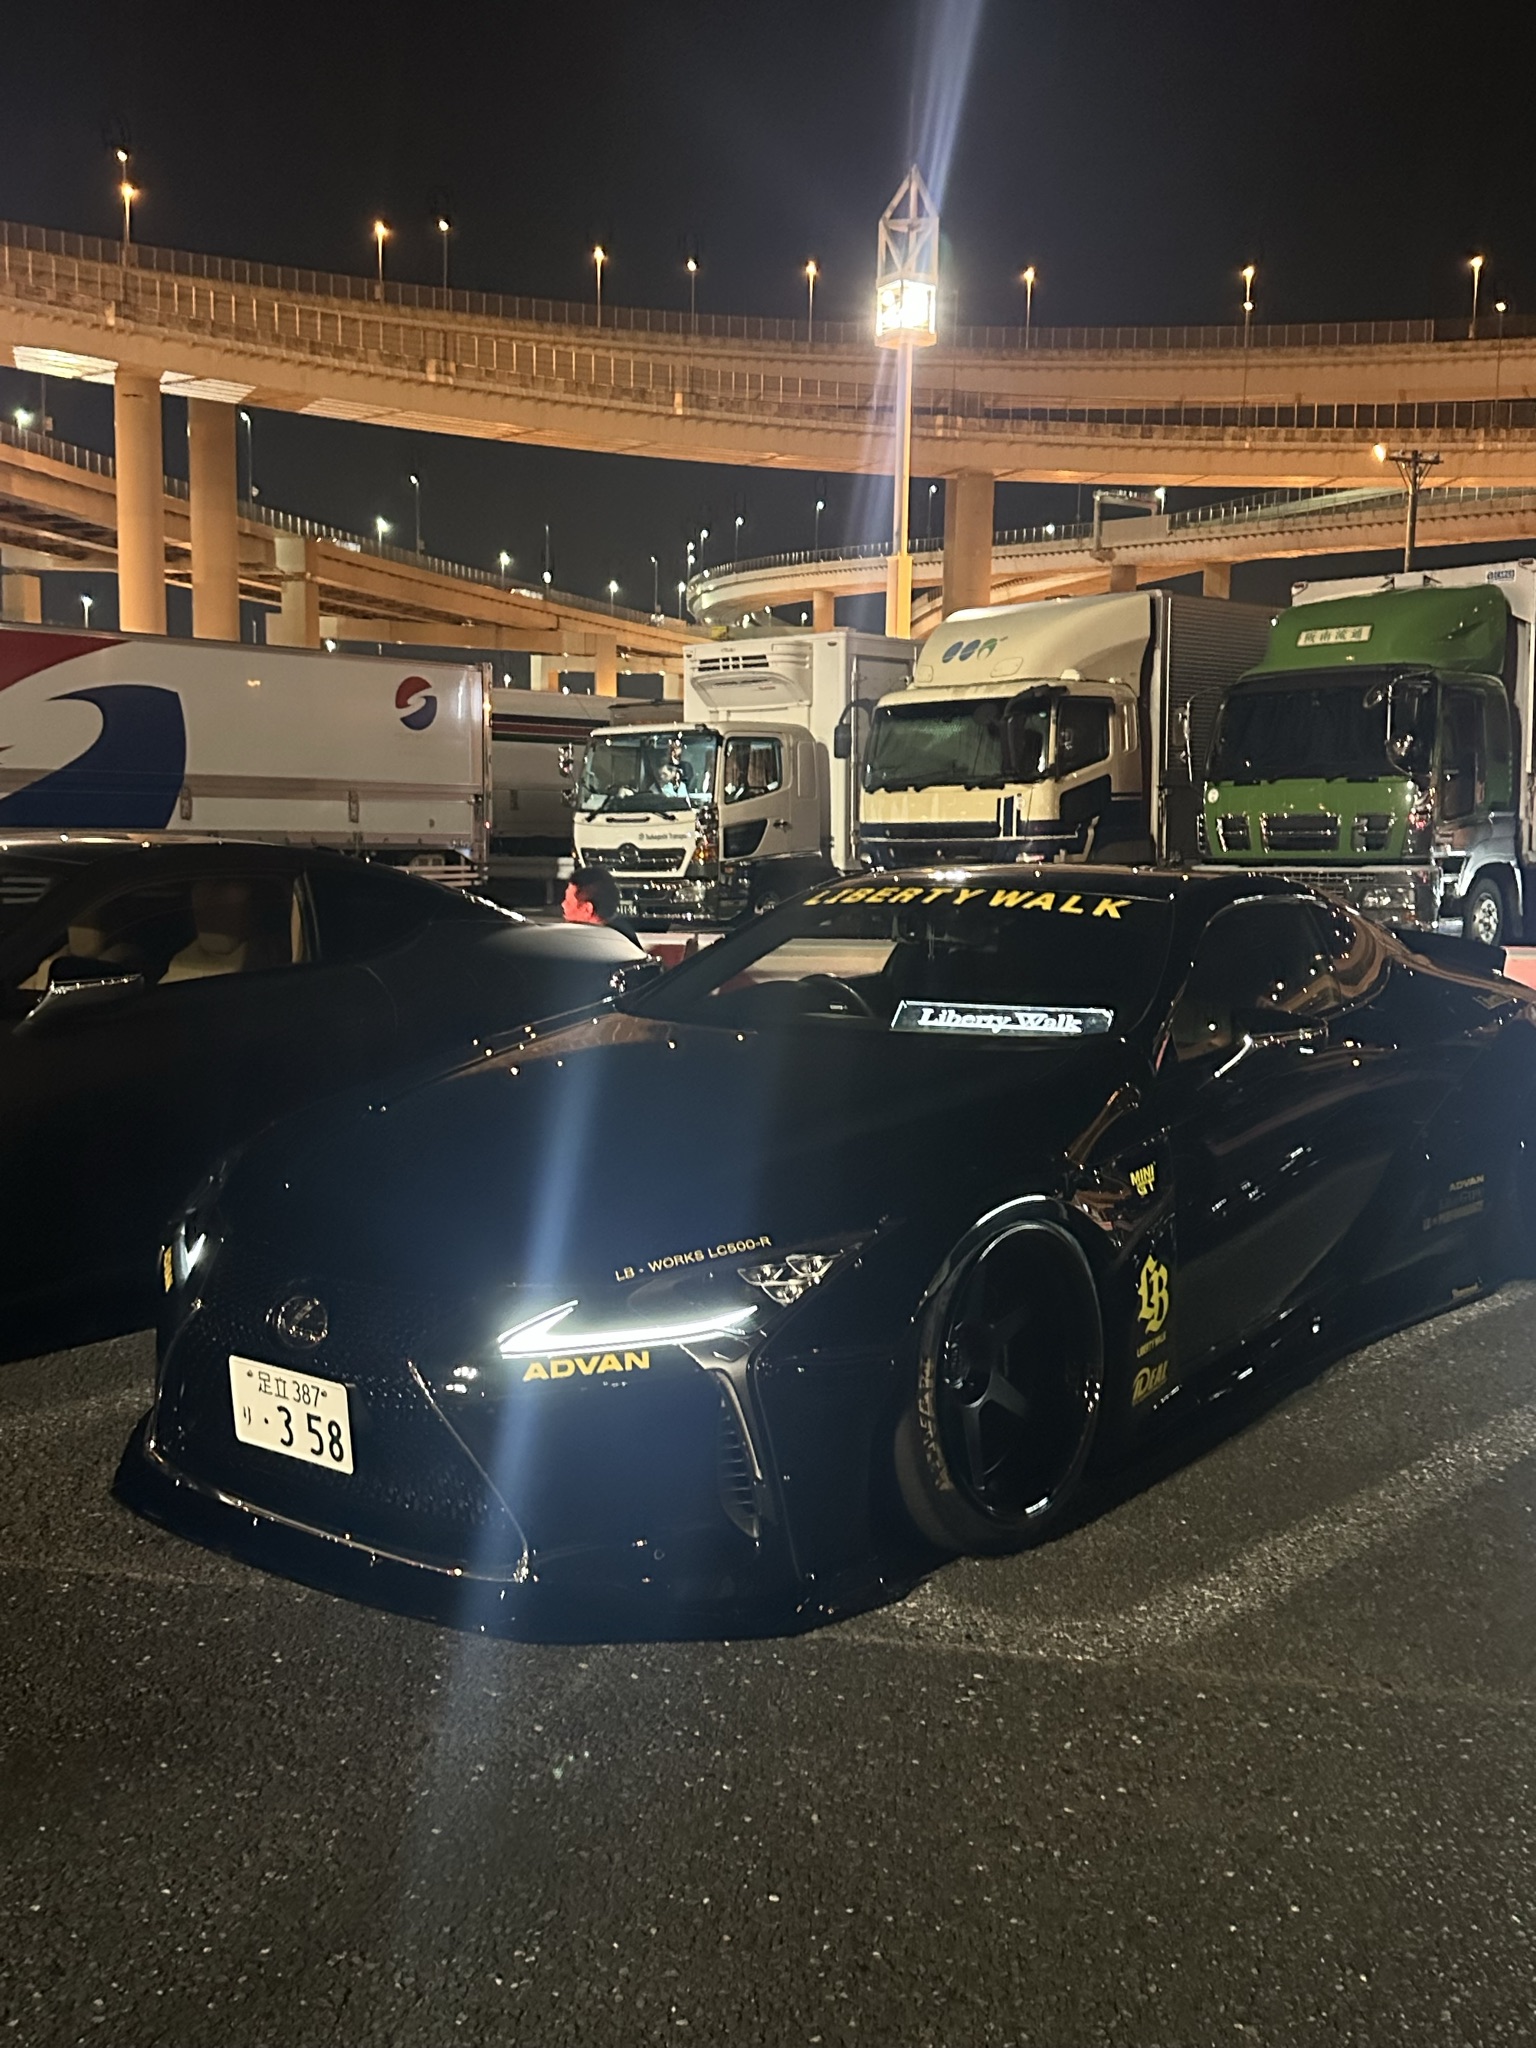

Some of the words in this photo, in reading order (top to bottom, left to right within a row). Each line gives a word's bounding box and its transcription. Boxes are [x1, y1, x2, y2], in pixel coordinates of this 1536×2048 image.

[803, 887, 987, 906] LIBERTY
[988, 889, 1133, 919] WALK
[918, 1008, 1011, 1033] Liberty
[1014, 1011, 1083, 1033] Walk
[1130, 1163, 1155, 1187] MINI
[1449, 1174, 1485, 1192] ADVAN
[615, 1266, 635, 1282] LB
[647, 1250, 704, 1273] WORKS
[707, 1236, 772, 1259] LC500-R
[522, 1350, 650, 1382] ADVAN
[258, 1371, 290, 1400] 足立
[292, 1380, 320, 1408] 387
[243, 1406, 252, 1425] り
